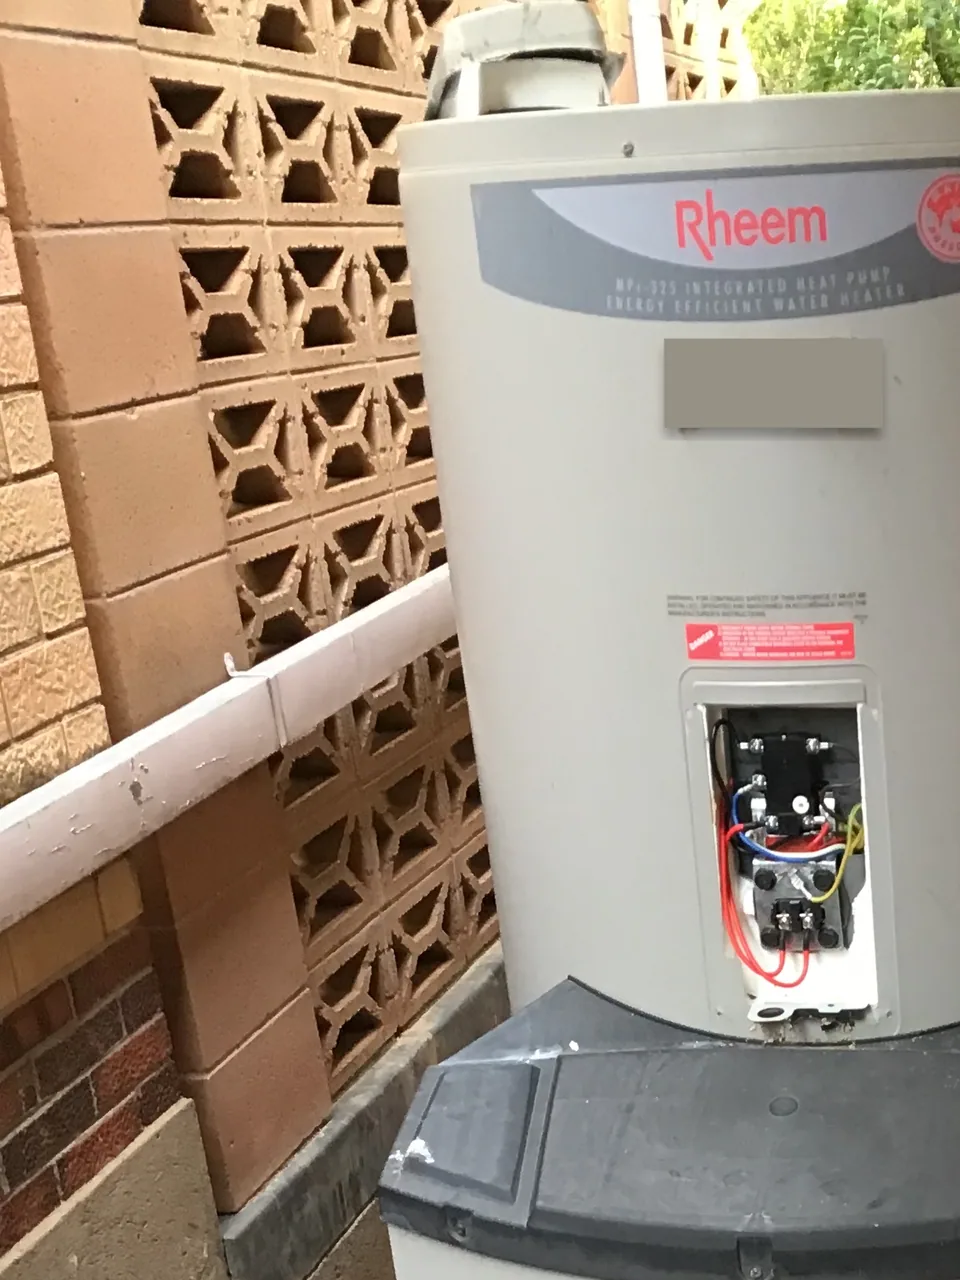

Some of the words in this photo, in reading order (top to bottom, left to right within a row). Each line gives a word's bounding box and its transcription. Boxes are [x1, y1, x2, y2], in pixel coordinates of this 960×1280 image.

[675, 188, 828, 262] Rheem
[684, 278, 787, 296] INTEGRATED
[796, 274, 837, 292] HEAT
[845, 266, 891, 286] PUMP
[606, 295, 664, 314] ENERGY
[674, 297, 763, 314] EFFICIENT
[773, 294, 829, 312] WATER
[841, 283, 905, 306] HEATER
